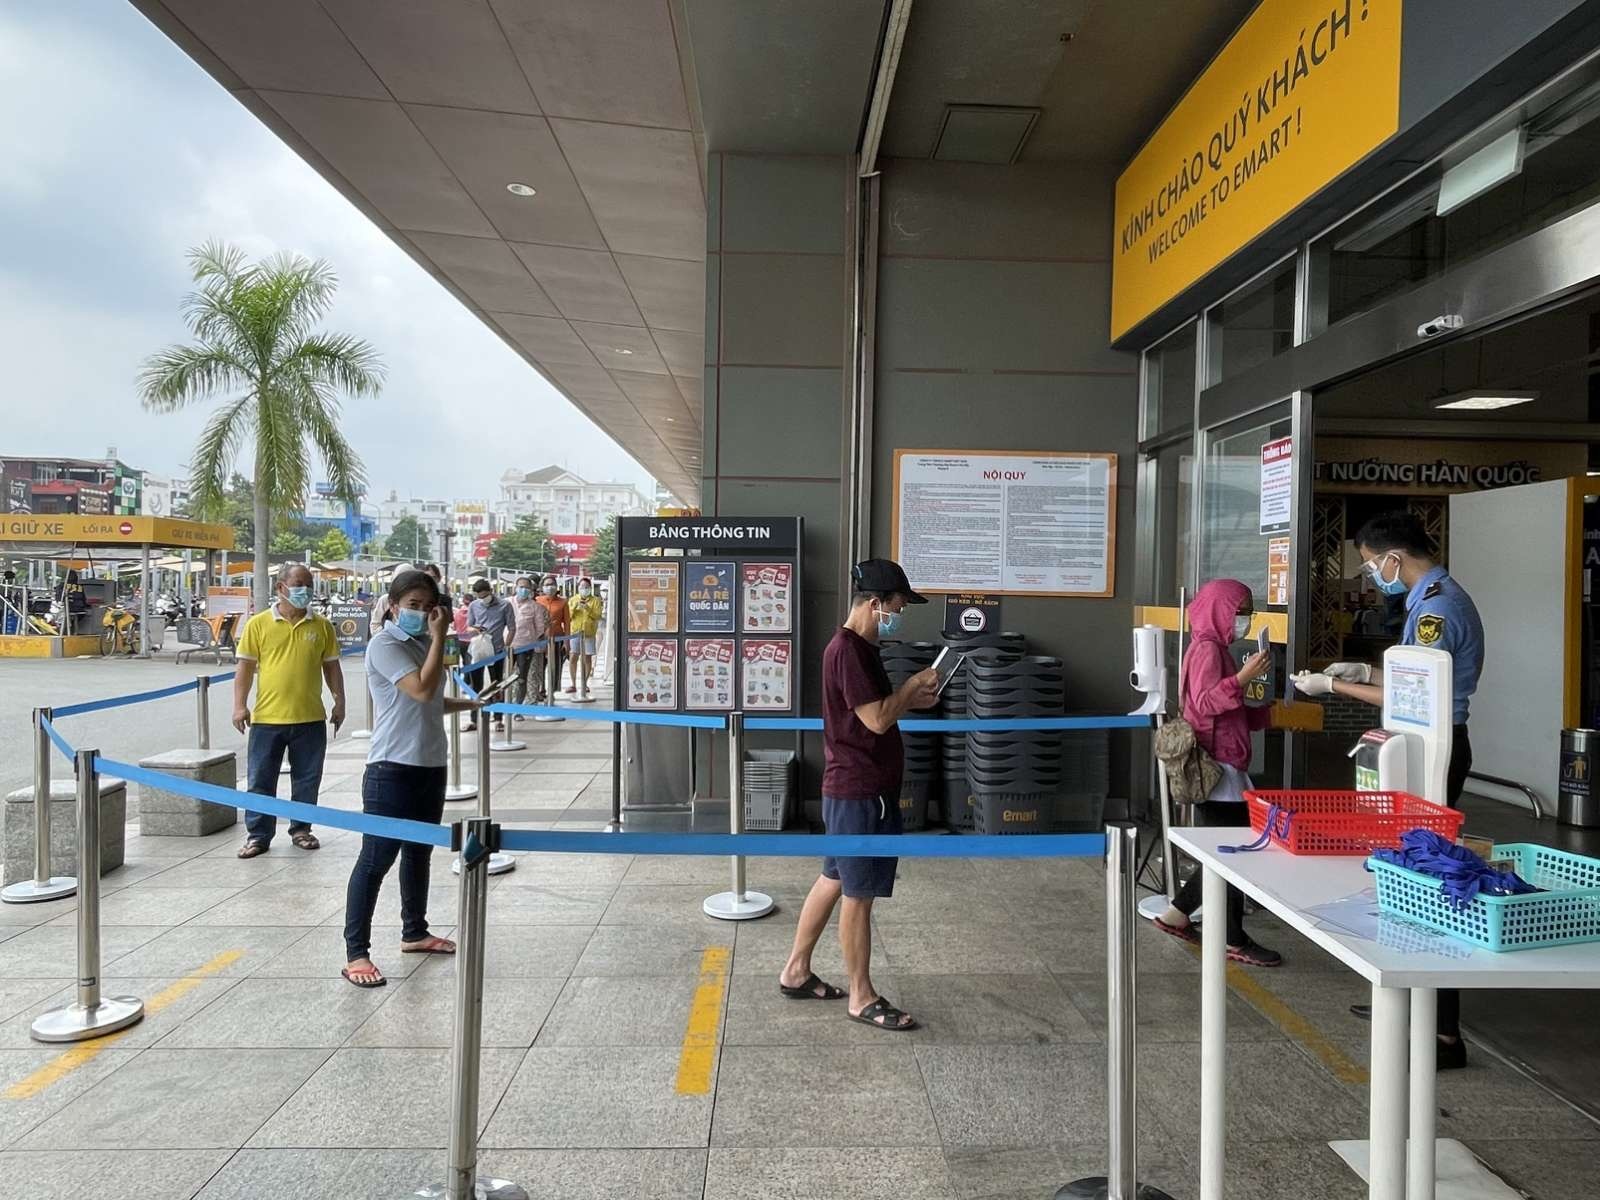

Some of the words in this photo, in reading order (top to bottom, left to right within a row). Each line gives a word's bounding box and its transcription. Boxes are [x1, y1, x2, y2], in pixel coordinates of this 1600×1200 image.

[1208, 91, 1251, 171] QUÝ
[1257, 0, 1350, 123] KHÁCH
[1148, 195, 1207, 264] WELCOME
[1210, 175, 1230, 210] TO
[1233, 115, 1292, 191] EMART
[983, 470, 1002, 482] NỘI
[1004, 472, 1027, 482] QUY
[1332, 457, 1414, 481] NƯỚNG
[1421, 459, 1468, 483] HÀN
[1476, 460, 1540, 487] QUỐC
[10, 519, 40, 536] GIỮ
[43, 523, 64, 536] XE
[100, 525, 113, 535] RA
[649, 523, 689, 539] BẢNG
[692, 523, 744, 539] THÔNG
[747, 526, 770, 539] TIN
[689, 588, 711, 600] GIÁ
[689, 600, 711, 611] QUỐC
[1003, 809, 1037, 823] emart
